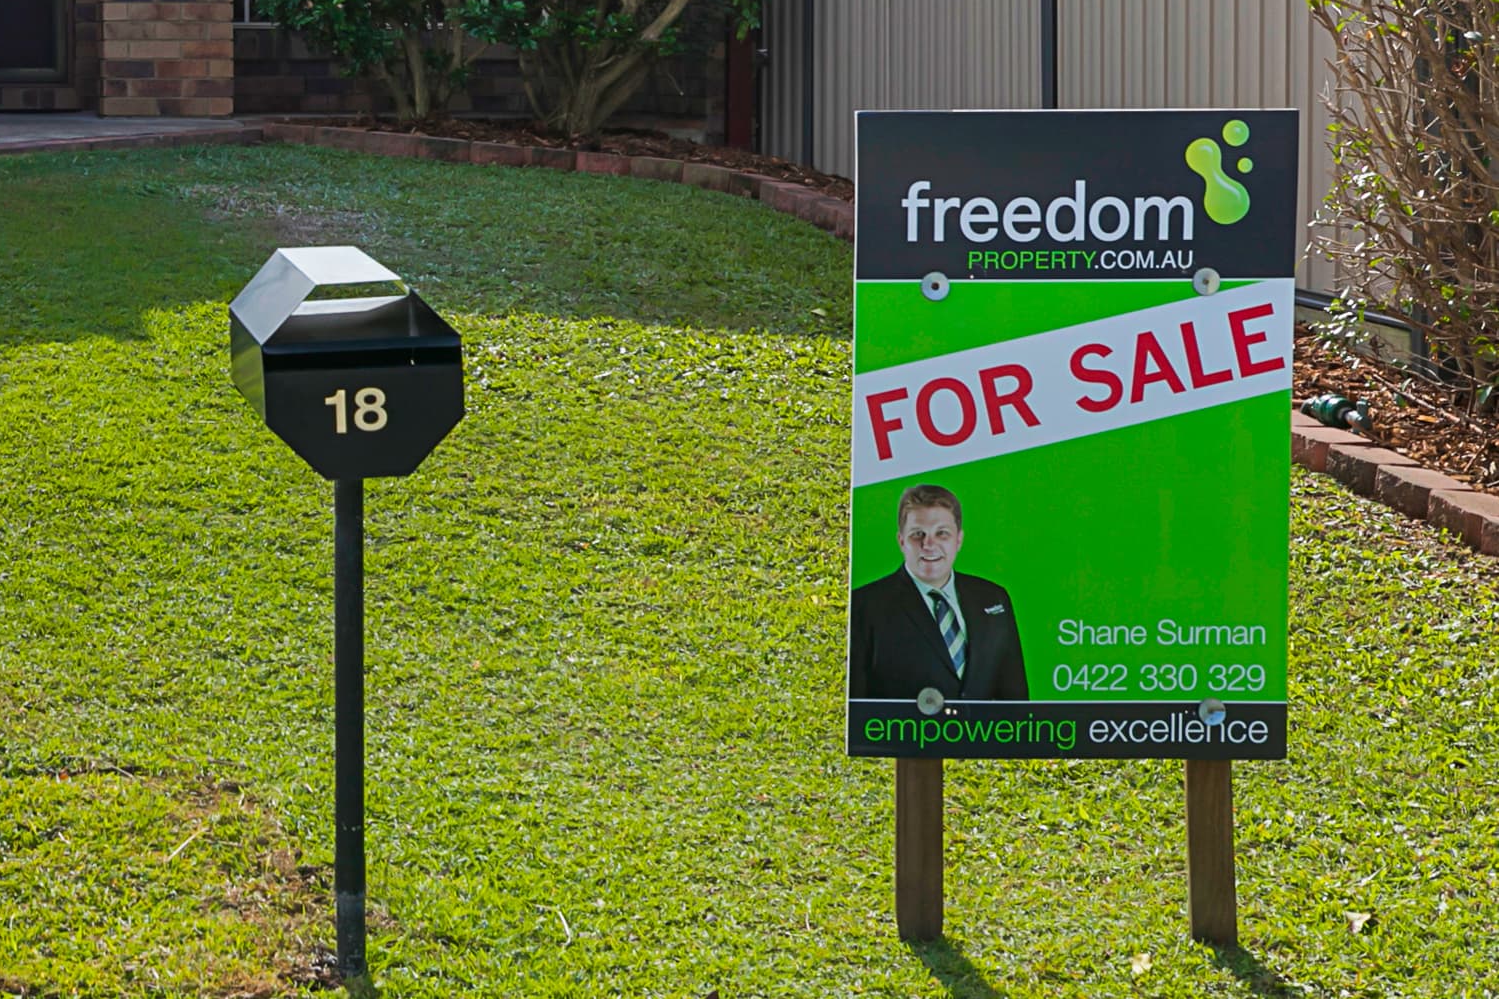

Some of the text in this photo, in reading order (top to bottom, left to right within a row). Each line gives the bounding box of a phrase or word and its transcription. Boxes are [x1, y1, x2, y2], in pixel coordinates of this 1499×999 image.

[901, 180, 1194, 243] freedom
[968, 250, 1193, 270] PROPERTY.COM.AU
[866, 303, 1285, 461] FOR SALE
[325, 387, 387, 433] 18
[1058, 619, 1266, 646] Shane Surman
[1053, 664, 1266, 692] 0422 330 329
[865, 713, 1268, 750] empowering excellence
